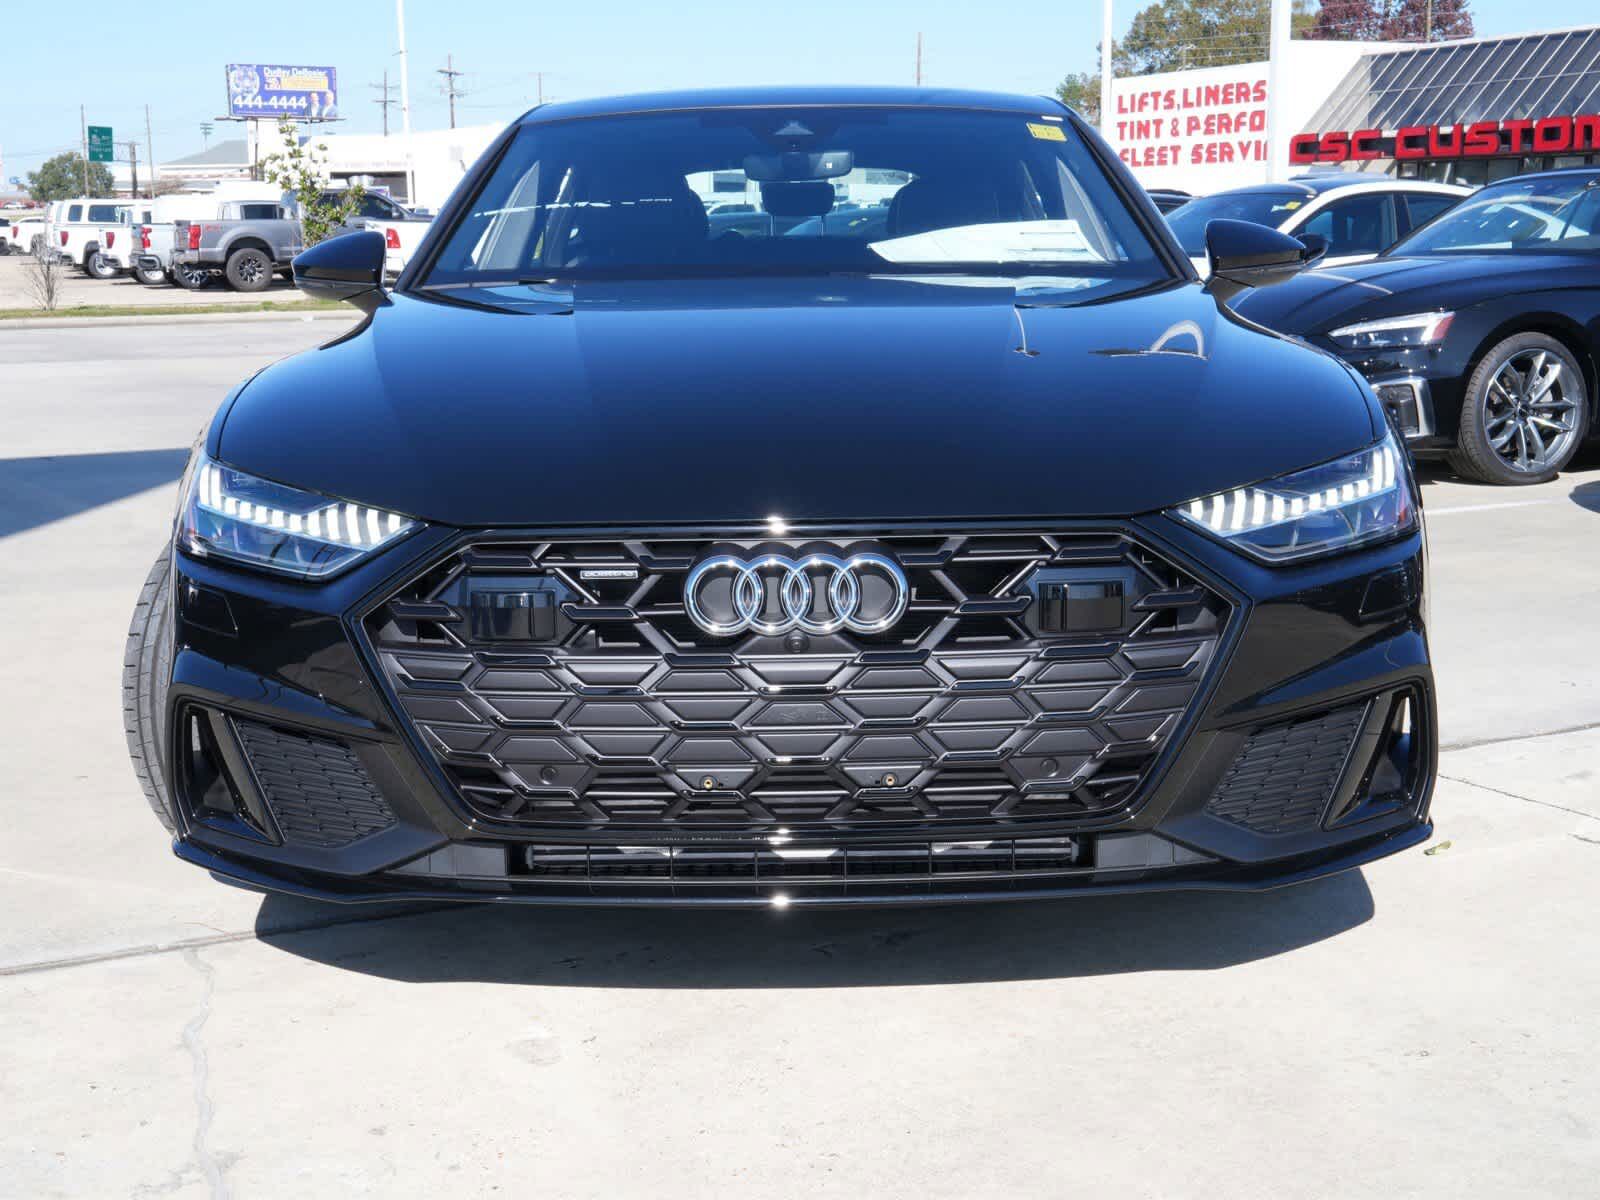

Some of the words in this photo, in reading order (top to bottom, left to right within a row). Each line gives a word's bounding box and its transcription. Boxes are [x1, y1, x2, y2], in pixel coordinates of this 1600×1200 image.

[233, 95, 307, 109] 444-4444
[1117, 118, 1163, 140] TINT
[1170, 117, 1180, 137] &
[1186, 110, 1265, 136] PERFO
[1191, 140, 1268, 164] SERVI
[1289, 129, 1383, 166] CSC
